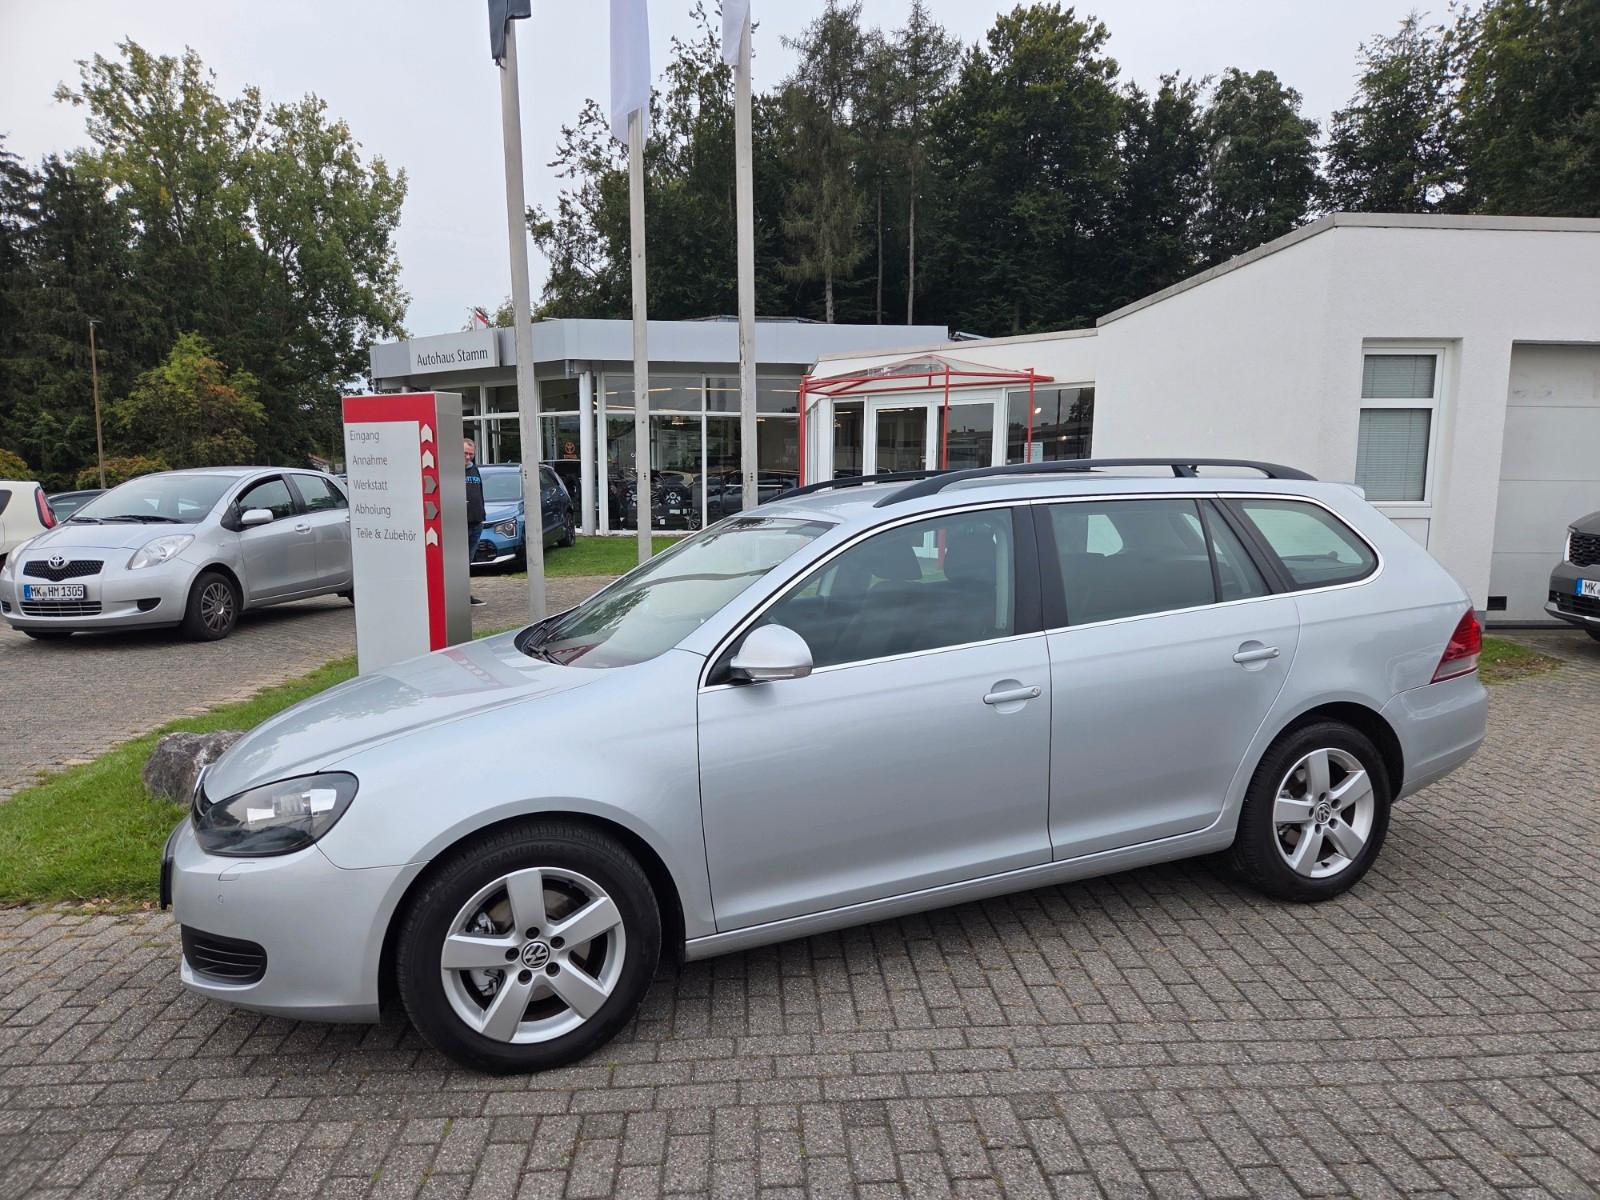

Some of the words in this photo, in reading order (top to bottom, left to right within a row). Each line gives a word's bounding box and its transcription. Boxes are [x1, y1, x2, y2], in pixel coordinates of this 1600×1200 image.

[417, 352, 455, 366] Autohaus
[457, 349, 488, 362] Stamm
[350, 430, 380, 443] Eingang
[353, 455, 388, 466] Annahme
[353, 479, 388, 491] Werkstatt
[355, 504, 391, 518] Abholung
[356, 528, 373, 539] Teile
[375, 529, 381, 539] &
[384, 529, 416, 541] Zubehör
[31, 587, 42, 597] MK
[48, 587, 60, 597] HM
[62, 586, 83, 597] 1305
[1584, 582, 1597, 594] MK
